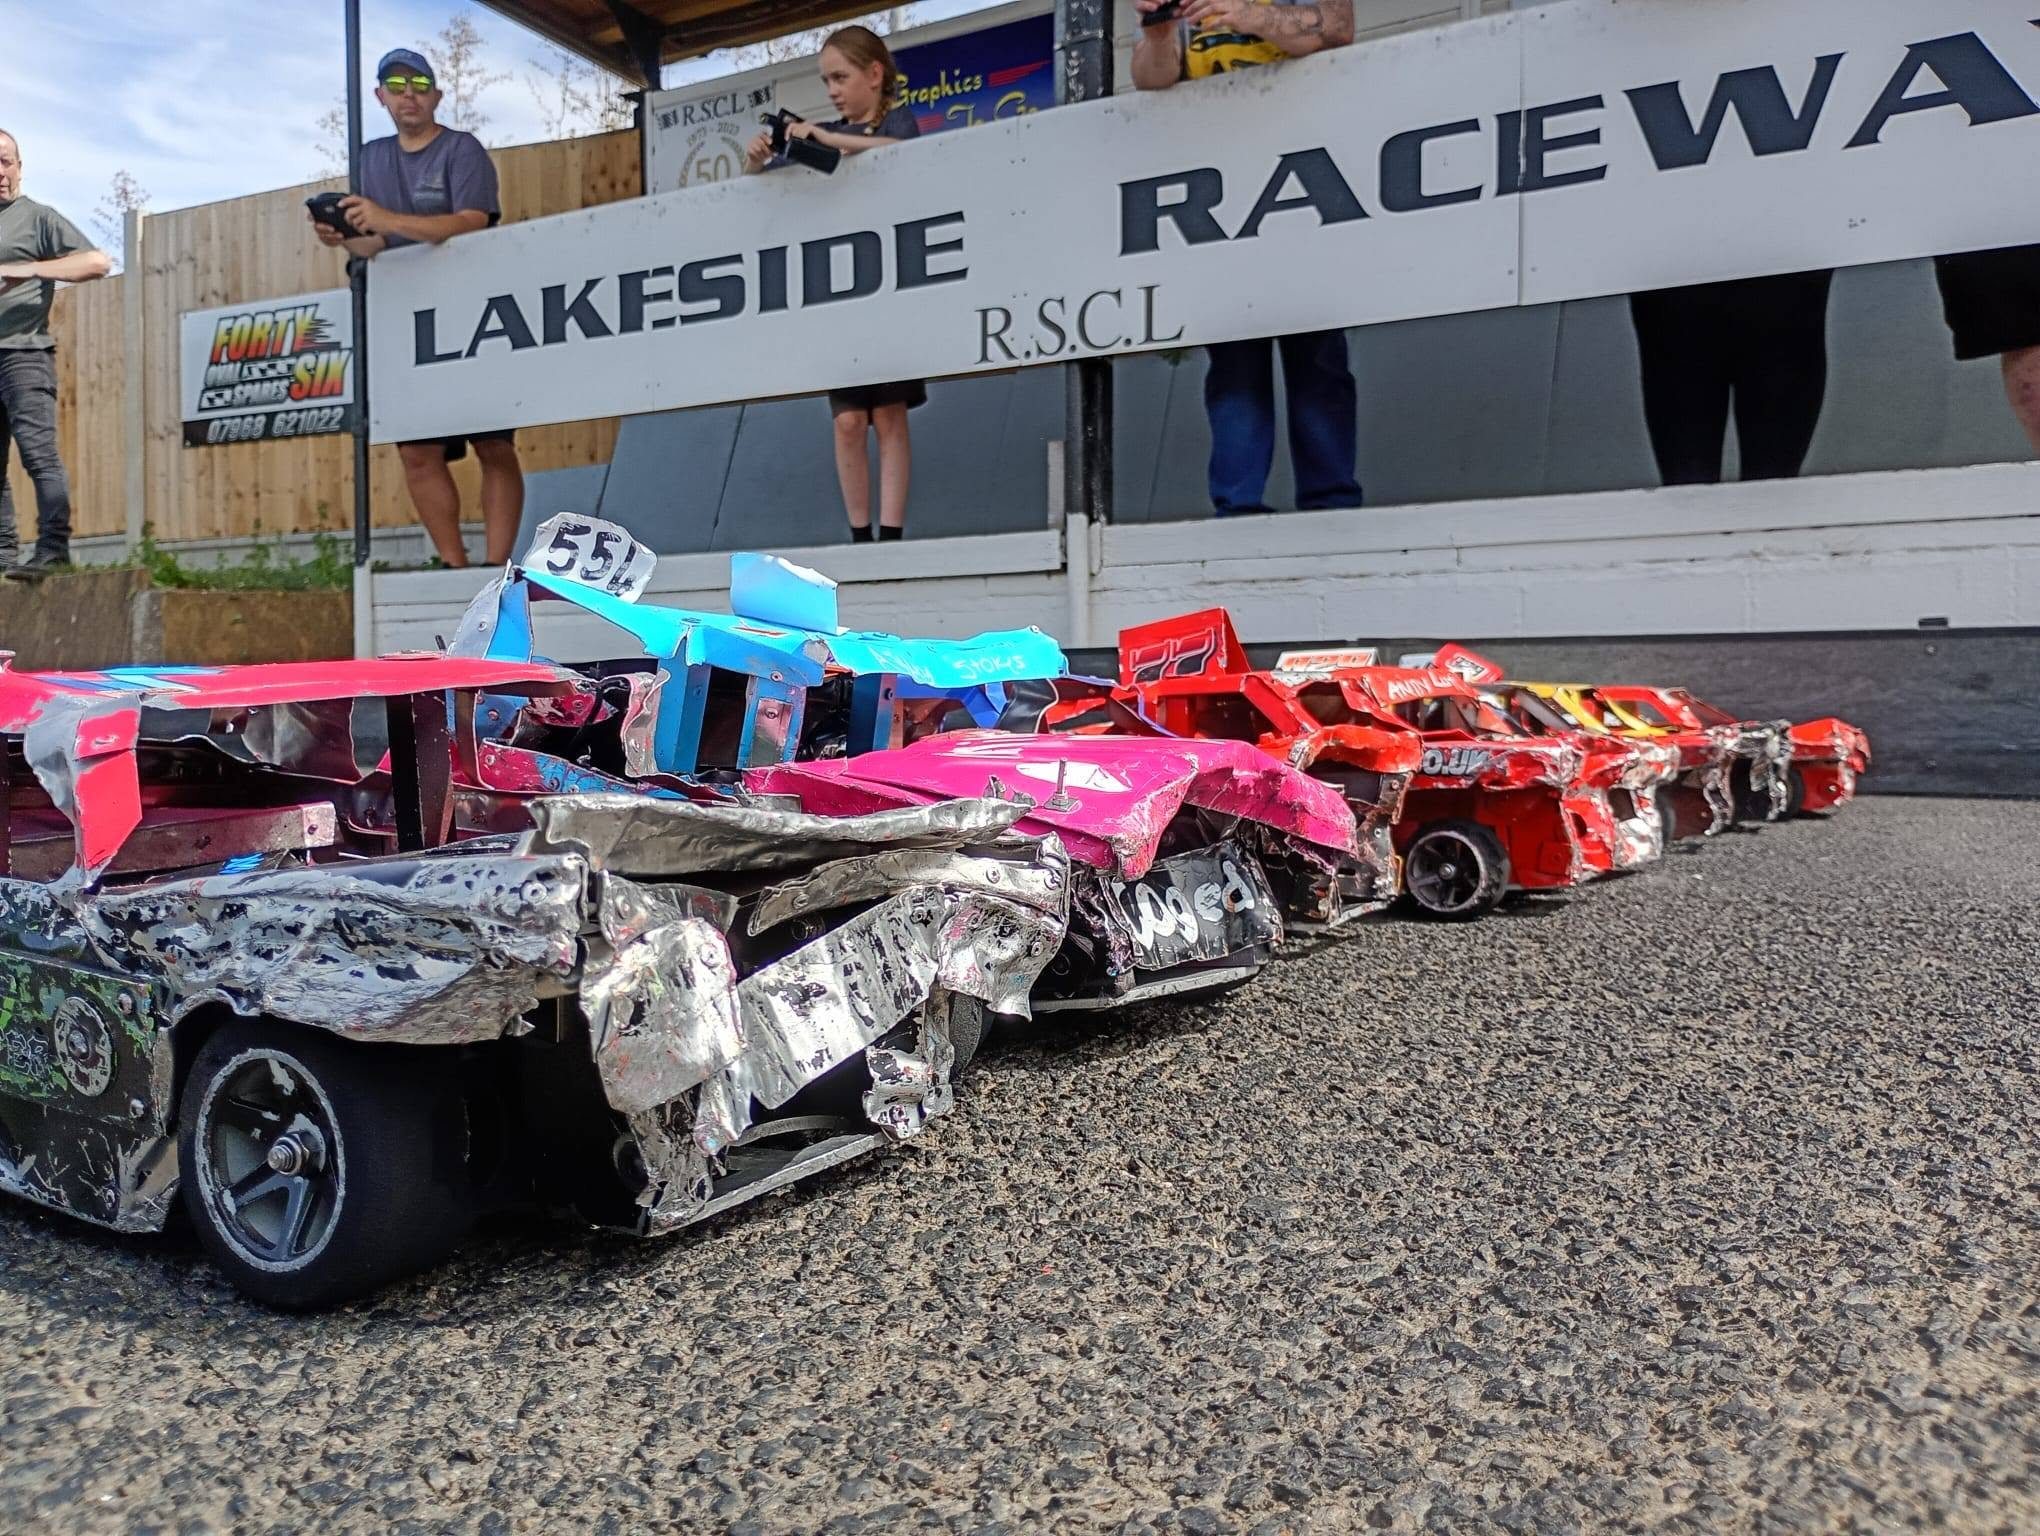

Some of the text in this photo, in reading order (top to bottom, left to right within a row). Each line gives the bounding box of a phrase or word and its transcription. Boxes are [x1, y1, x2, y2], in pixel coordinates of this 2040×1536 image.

[891, 68, 983, 110] Graphics
[414, 19, 2040, 367] LAKESIDE RACEWA
[696, 154, 731, 182] 50
[210, 303, 320, 364] FORTY
[289, 348, 351, 400] SIX
